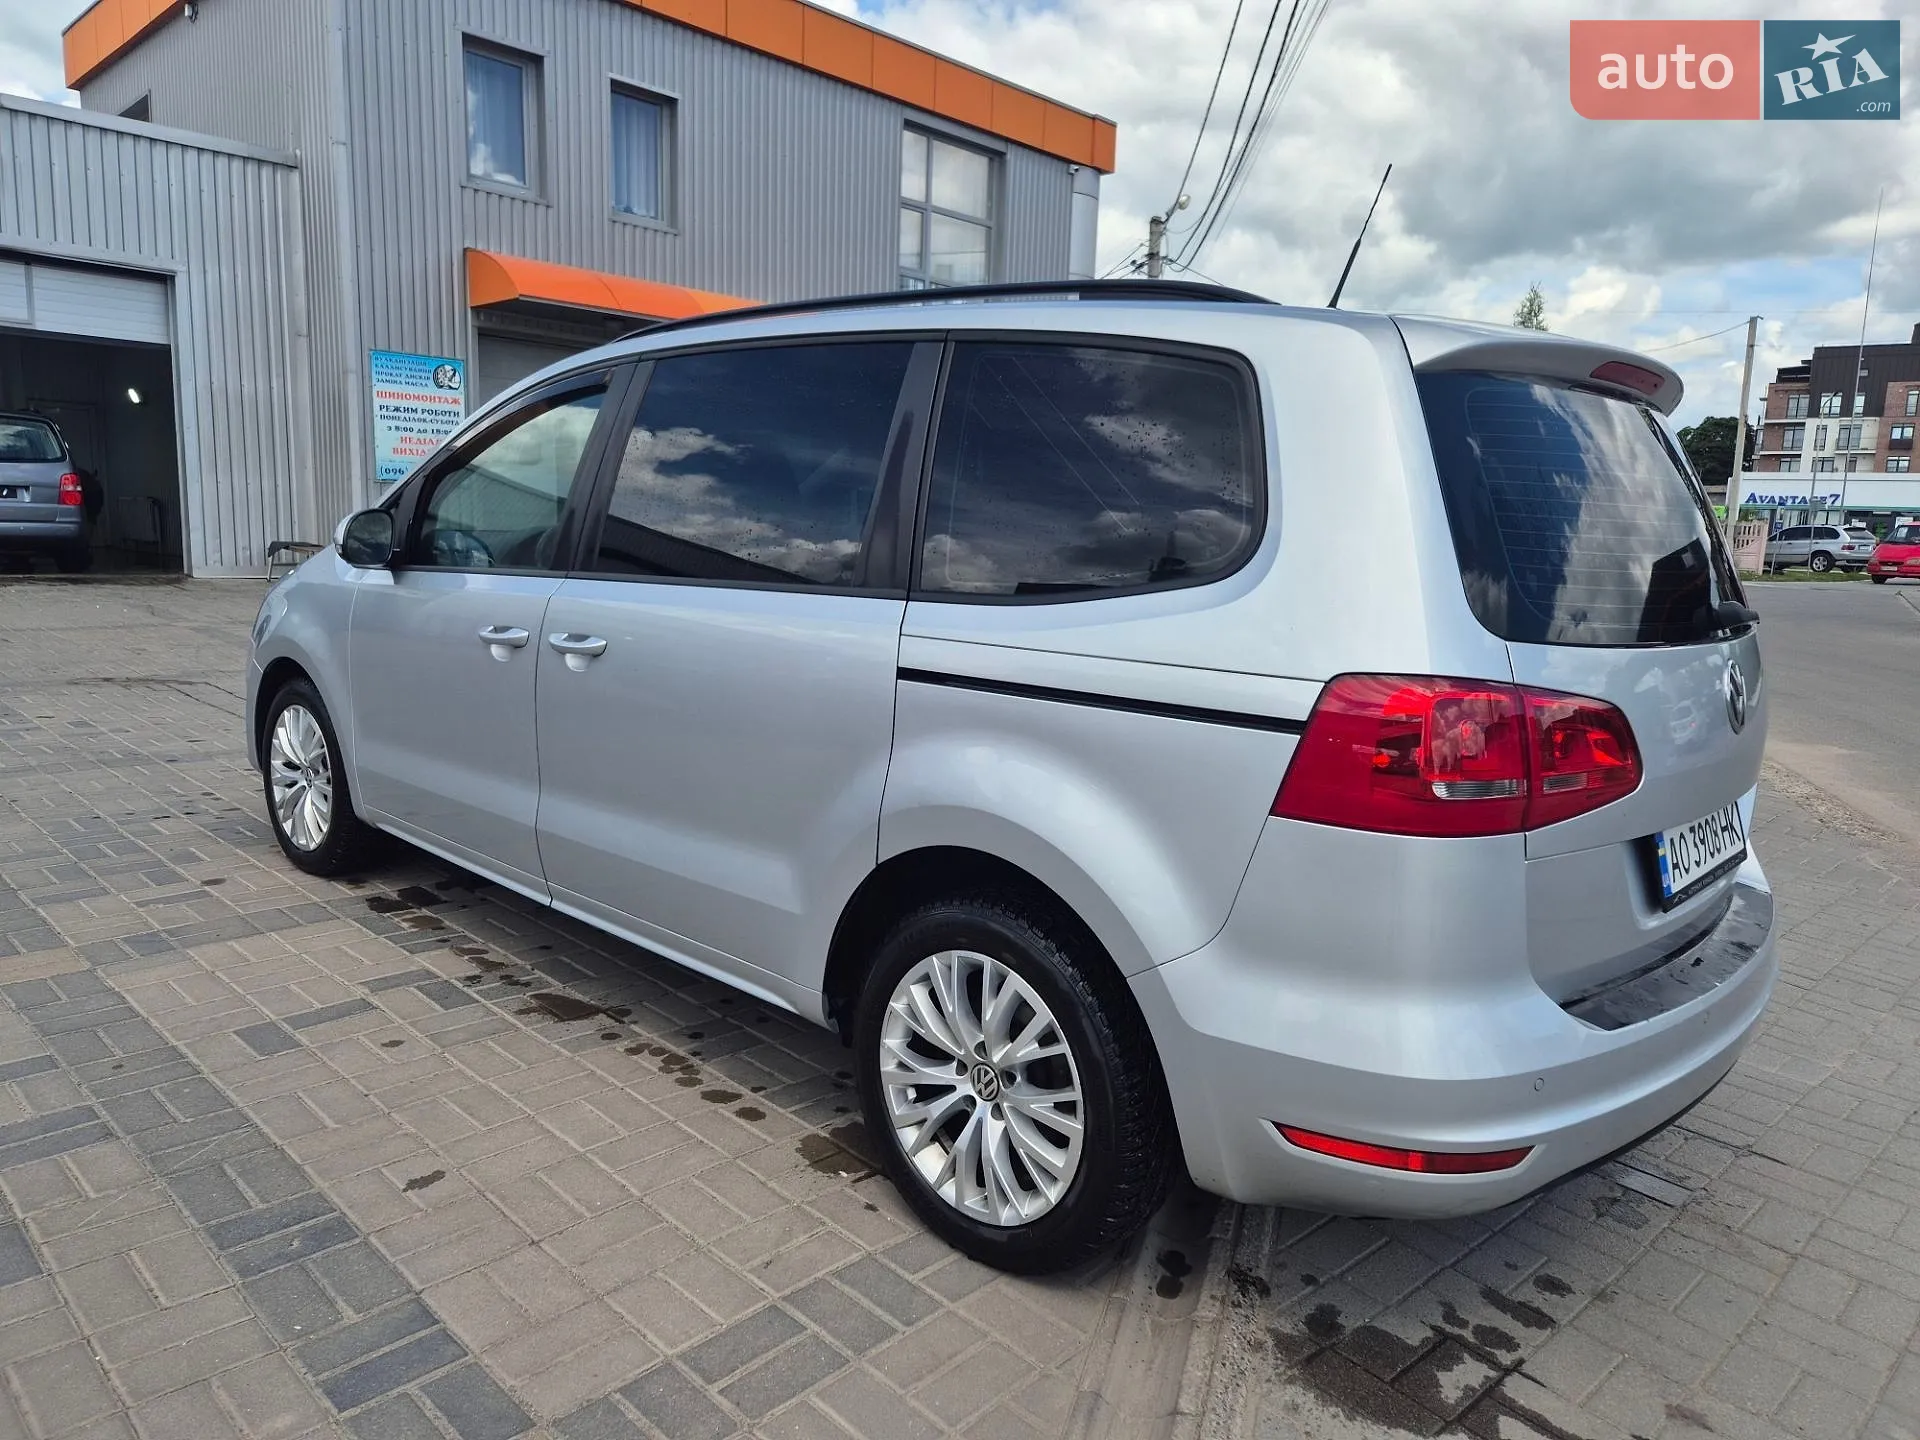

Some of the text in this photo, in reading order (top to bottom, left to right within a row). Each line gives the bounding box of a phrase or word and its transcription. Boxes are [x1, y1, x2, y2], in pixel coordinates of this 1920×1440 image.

[376, 390, 461, 405] ШИНОМОНТАЖ
[379, 404, 460, 418] РЕЖИМ РОБОТИ
[1669, 831, 1691, 883] AO
[1688, 814, 1721, 868] 3908
[1717, 802, 1741, 851] HK
